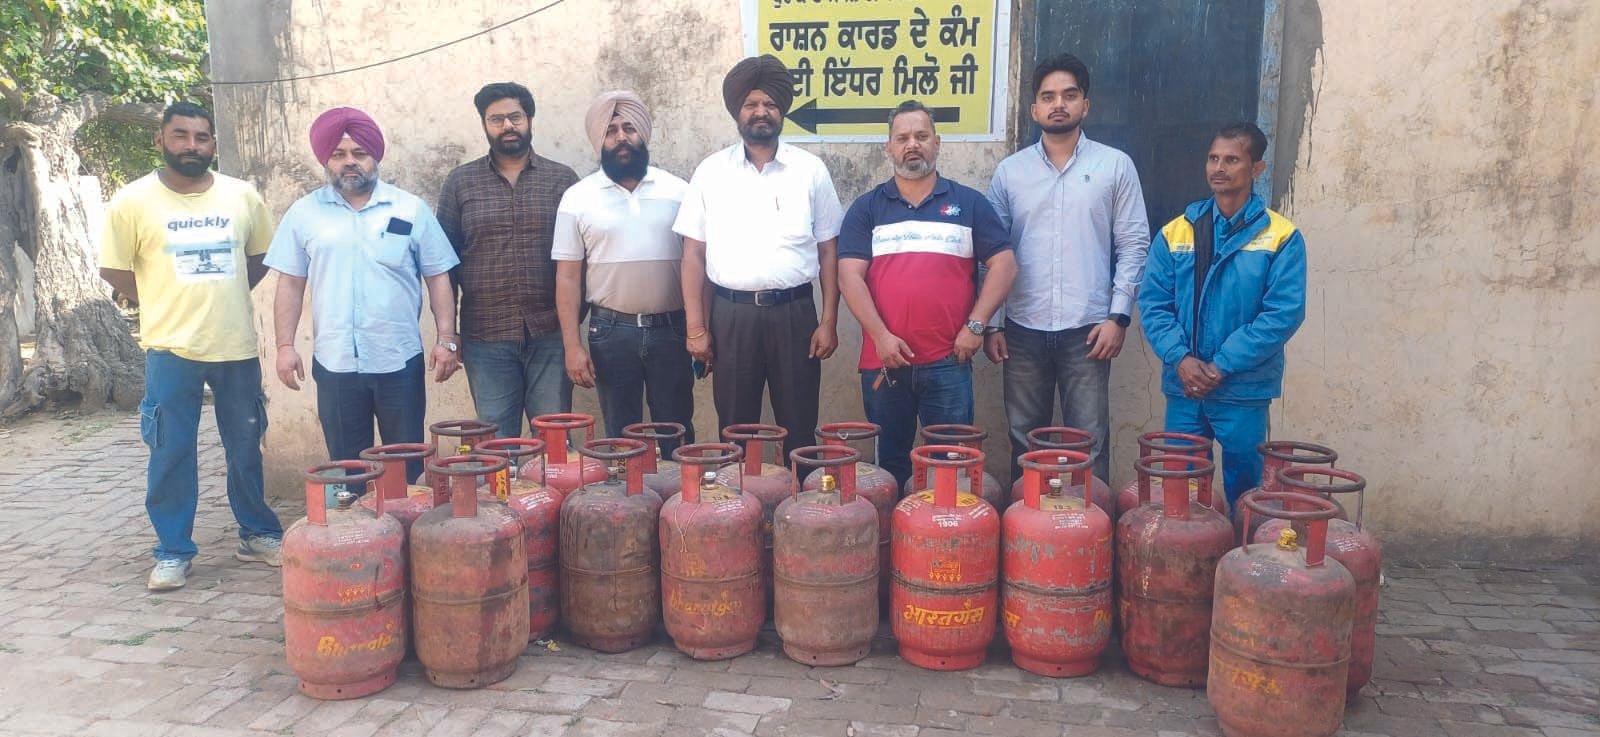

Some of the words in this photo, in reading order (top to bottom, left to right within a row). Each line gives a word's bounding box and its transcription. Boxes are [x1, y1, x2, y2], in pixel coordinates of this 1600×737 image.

[769, 22, 829, 51] ਰਾਸ਼ਨ
[838, 20, 900, 50] ਕਾਰਡ
[910, 7, 930, 48] ਦੇ
[940, 5, 980, 47] ਕੰਮ
[788, 57, 814, 97] ਈ
[823, 56, 883, 96] ਇੱਧਰ
[893, 52, 940, 95] ਮਿਲੋ
[950, 53, 978, 94] ਜੀ
[167, 216, 230, 231] quickly
